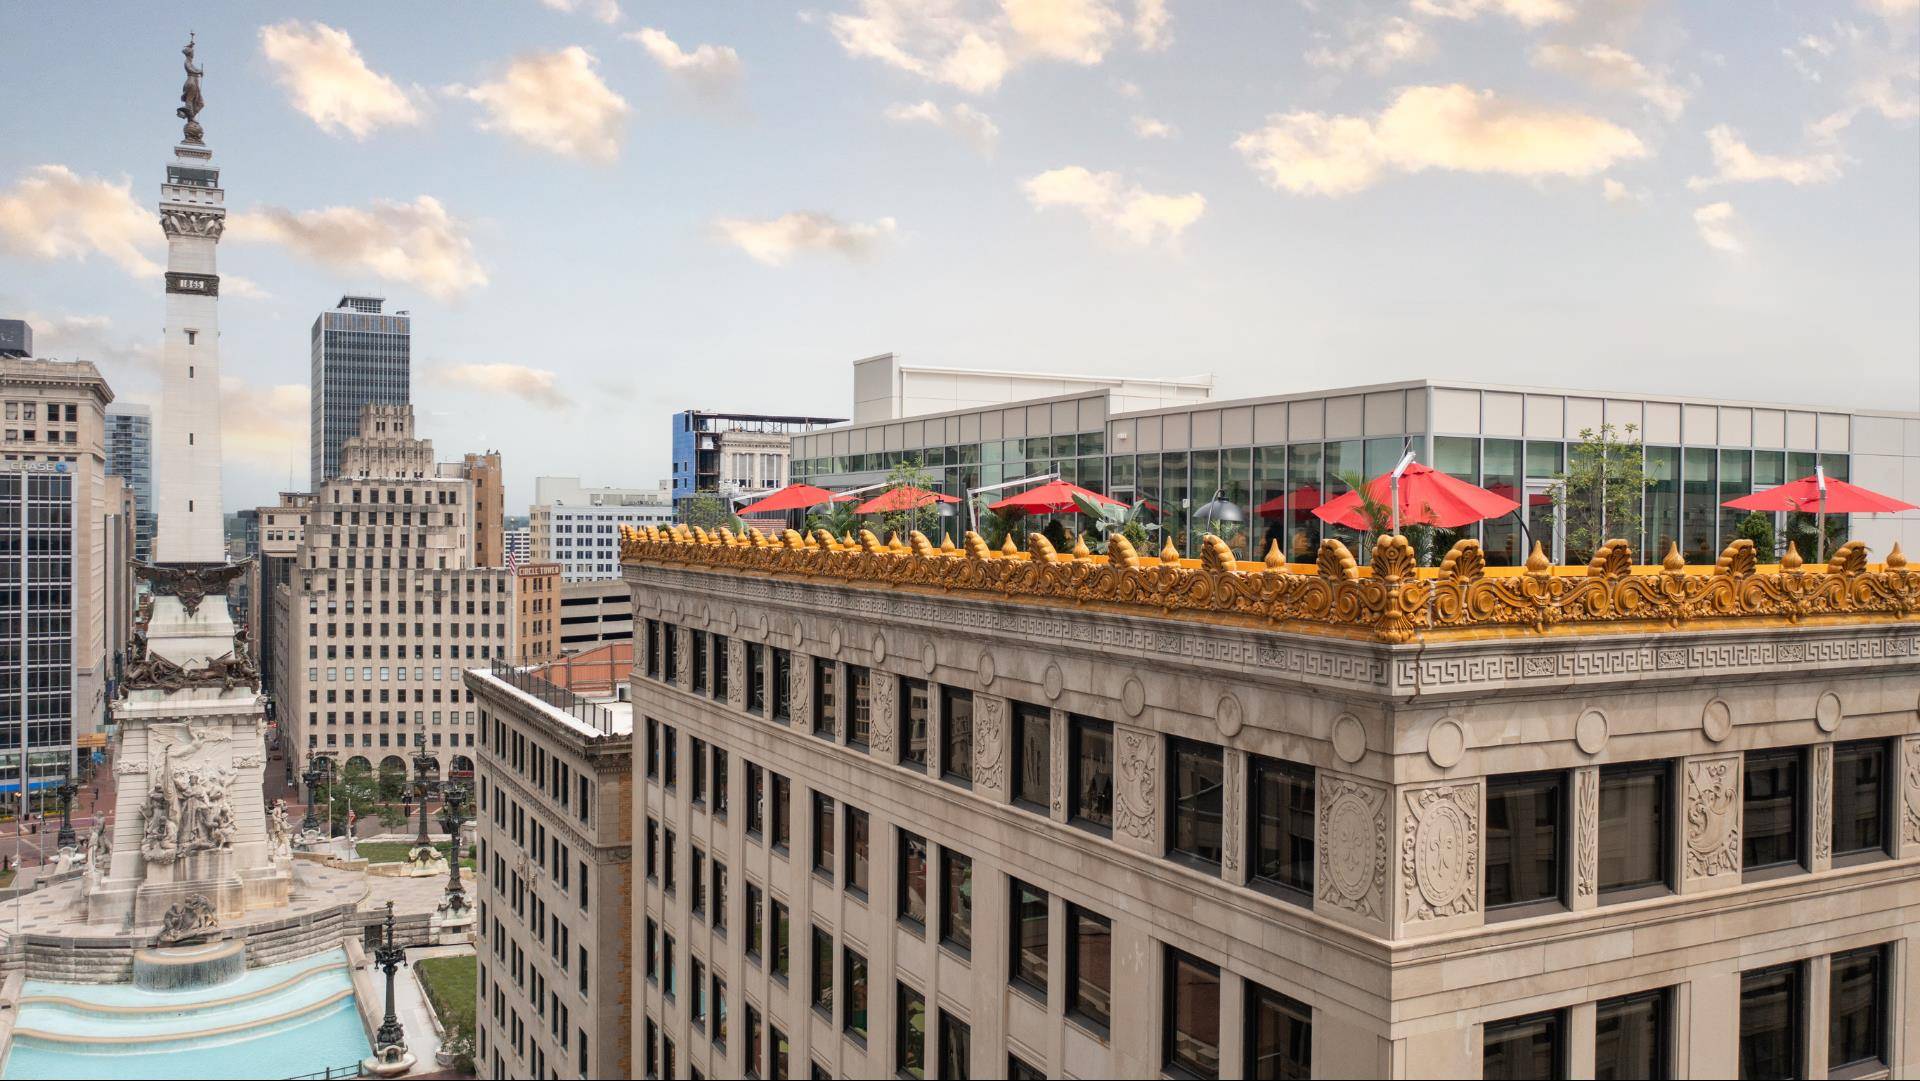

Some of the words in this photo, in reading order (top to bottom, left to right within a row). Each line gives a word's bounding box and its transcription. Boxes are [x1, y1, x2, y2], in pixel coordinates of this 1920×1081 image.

[10, 462, 54, 471] CHASE
[518, 567, 540, 576] CIRCLE
[540, 566, 560, 575] TOWER
